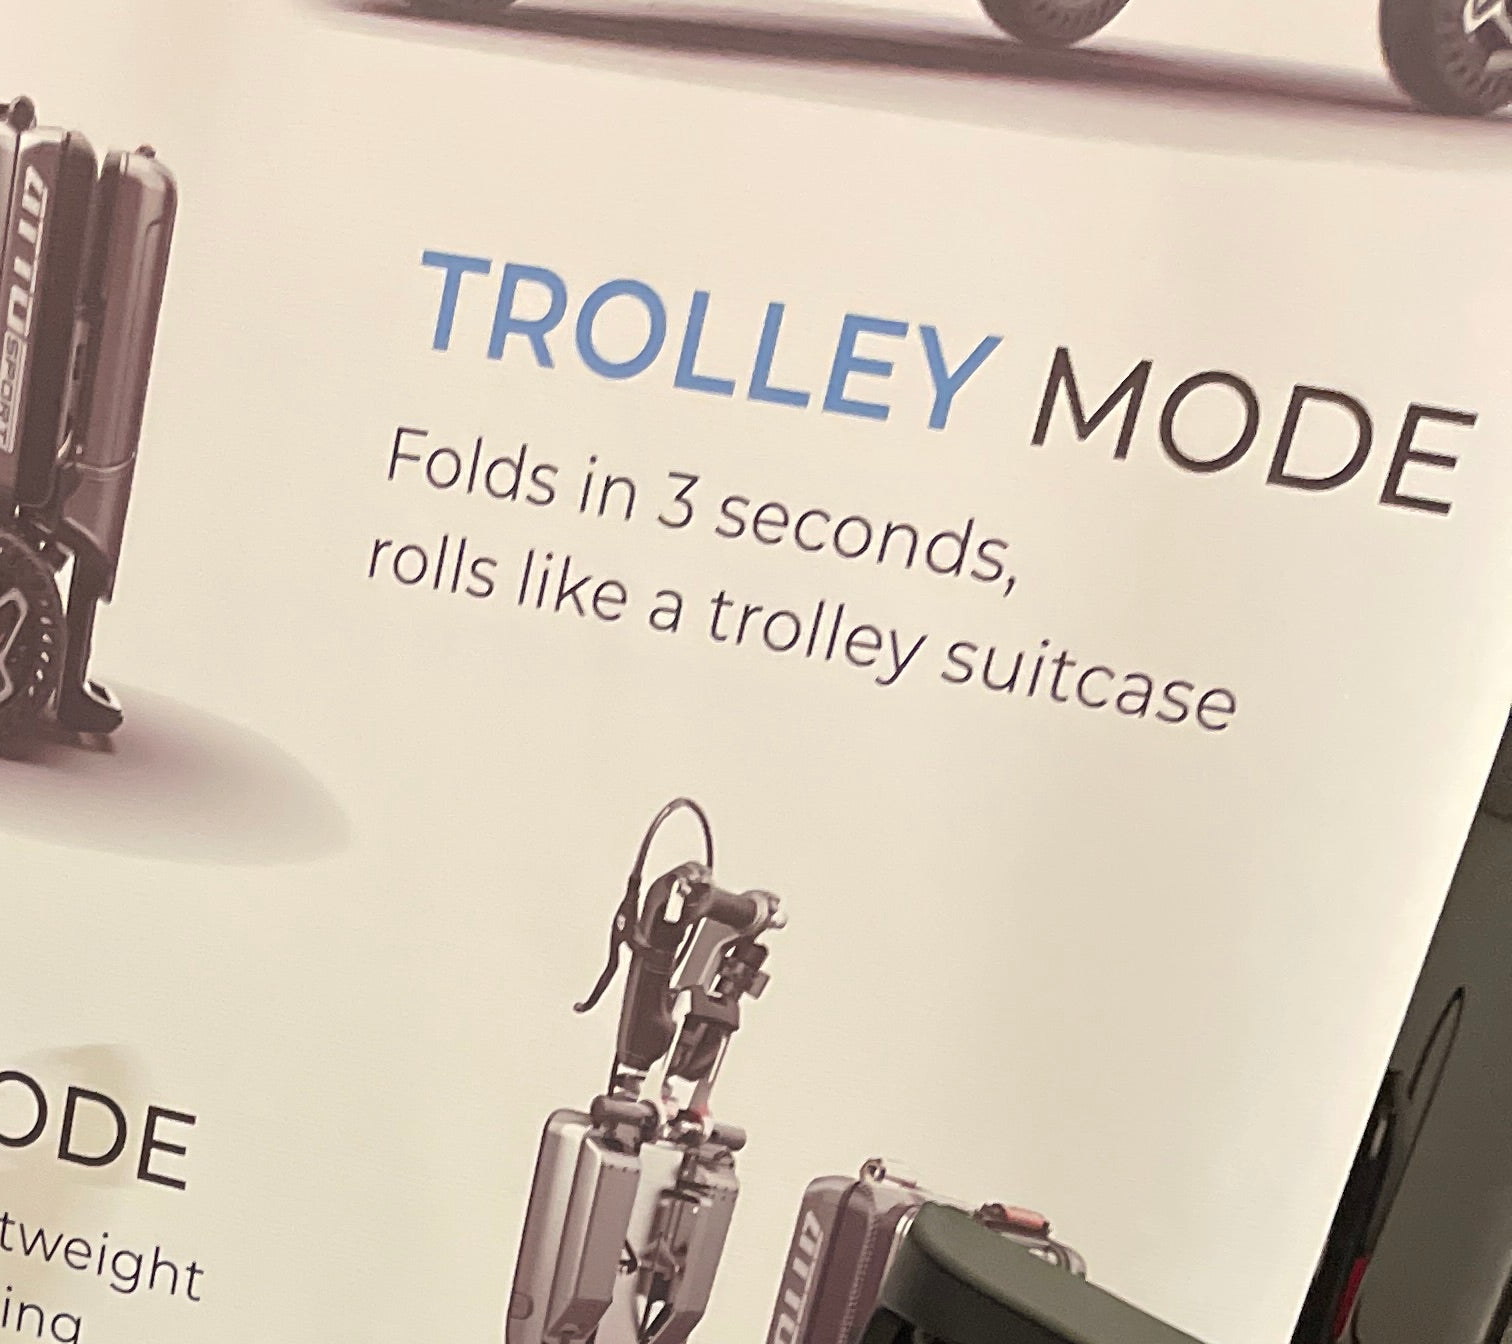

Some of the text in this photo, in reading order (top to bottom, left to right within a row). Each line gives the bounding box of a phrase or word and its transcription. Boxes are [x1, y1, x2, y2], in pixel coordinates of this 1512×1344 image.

[420, 249, 1479, 517] TROLLEY MODE
[386, 425, 1020, 596] Folds in 3 seconds,
[366, 529, 1239, 735] rolls like a trolley suitcase
